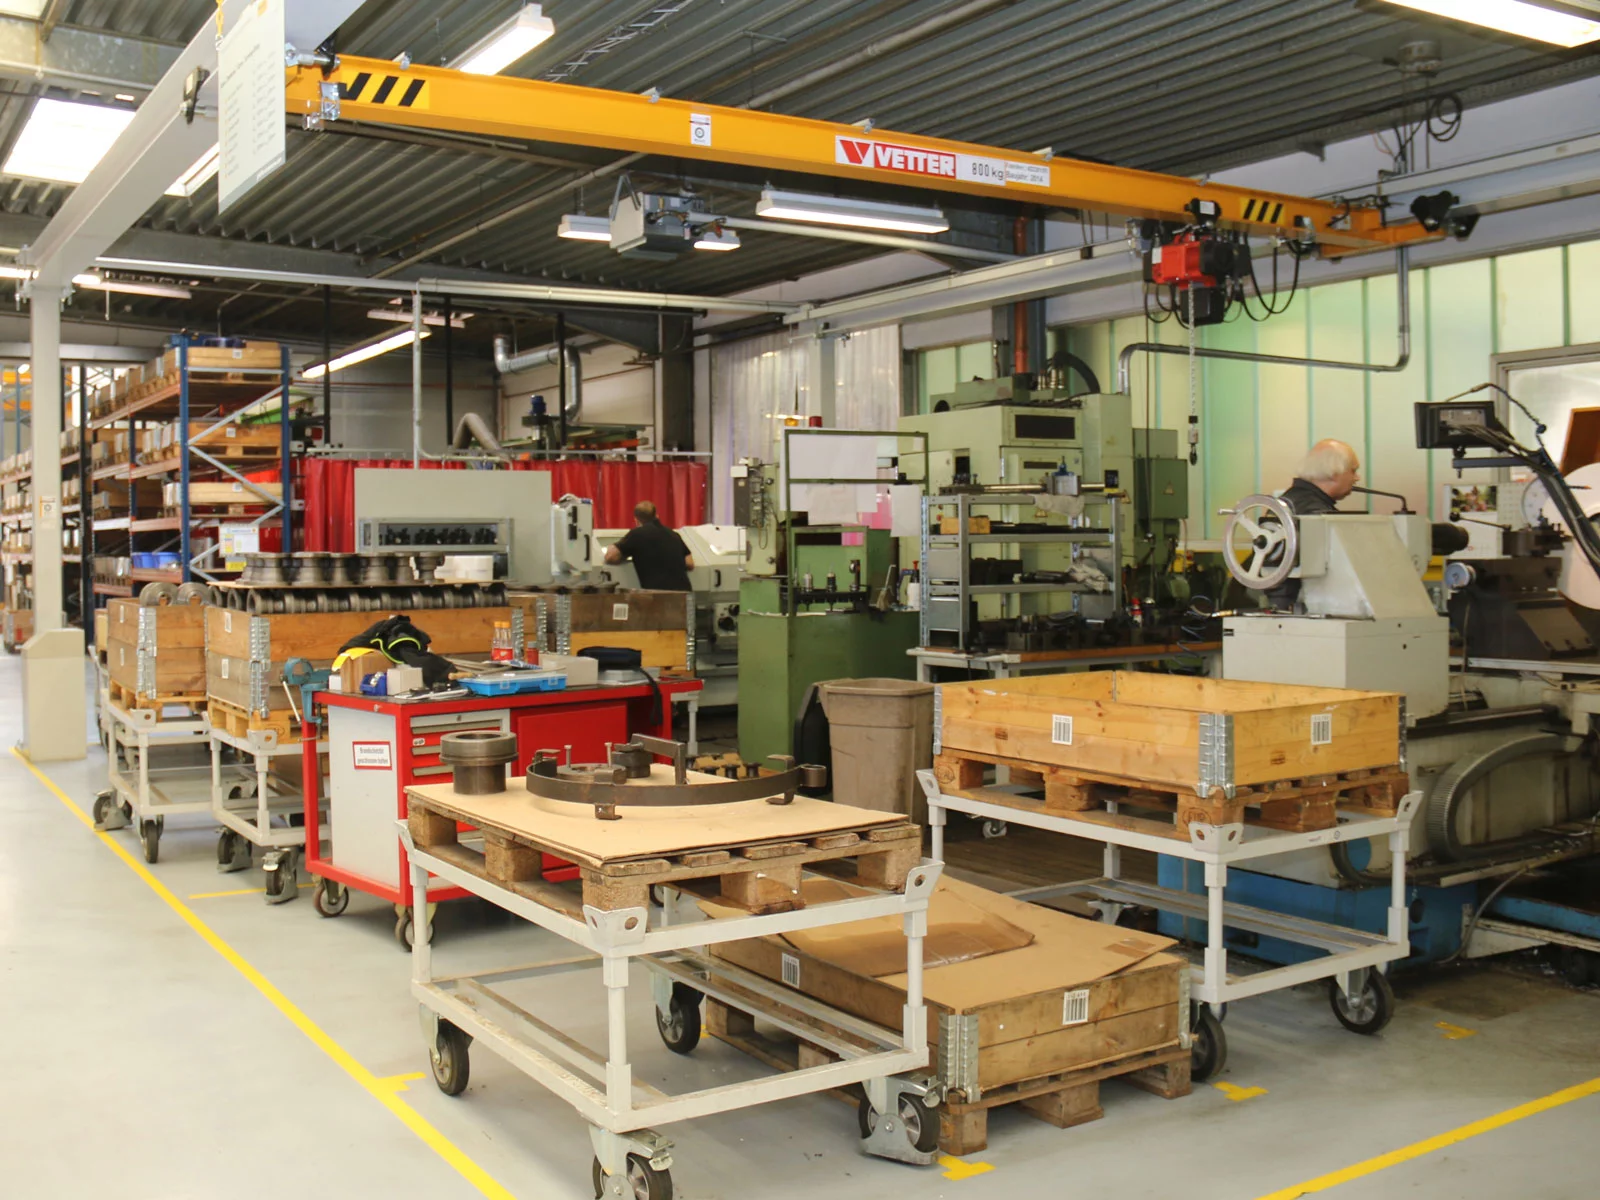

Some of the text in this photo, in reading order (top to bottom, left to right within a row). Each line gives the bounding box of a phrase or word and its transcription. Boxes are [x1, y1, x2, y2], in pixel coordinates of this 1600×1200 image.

[874, 144, 956, 178] VETTER
[971, 162, 989, 177] 800
[991, 167, 1004, 181] kg
